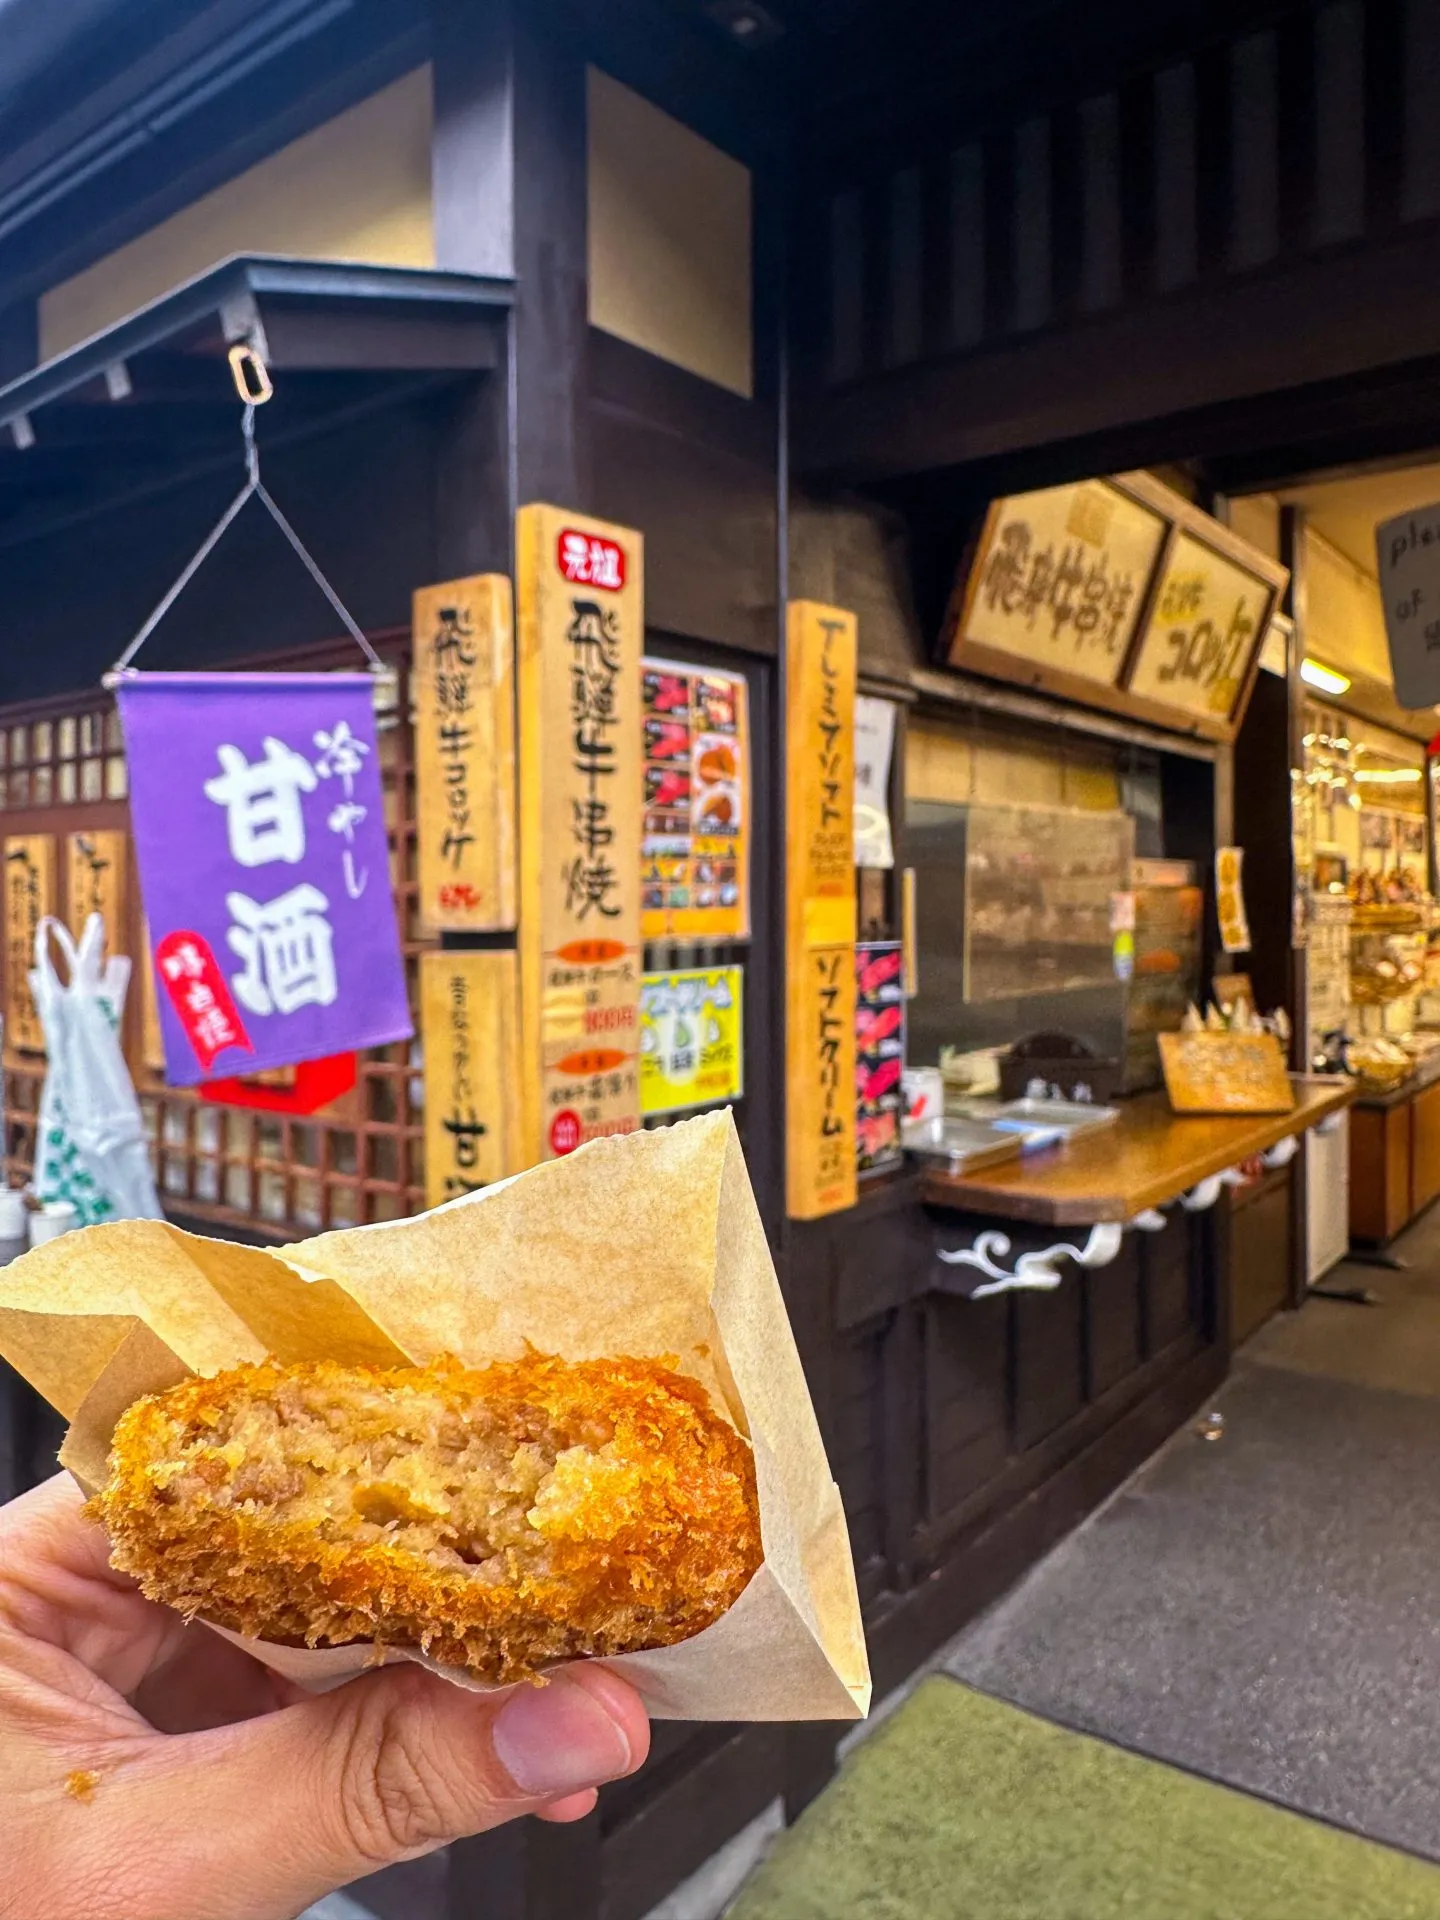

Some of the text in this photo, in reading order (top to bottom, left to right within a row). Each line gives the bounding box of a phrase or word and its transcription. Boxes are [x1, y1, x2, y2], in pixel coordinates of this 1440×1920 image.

[562, 534, 622, 588] 元祖
[1390, 519, 1440, 568] ple
[313, 720, 370, 900] 冷やし
[434, 606, 477, 871] 飛騨牛コロッケ
[562, 597, 621, 921] 飛騨牛串焼
[204, 735, 339, 1016] 甘酒
[816, 954, 844, 1138] ソフトクリーム
